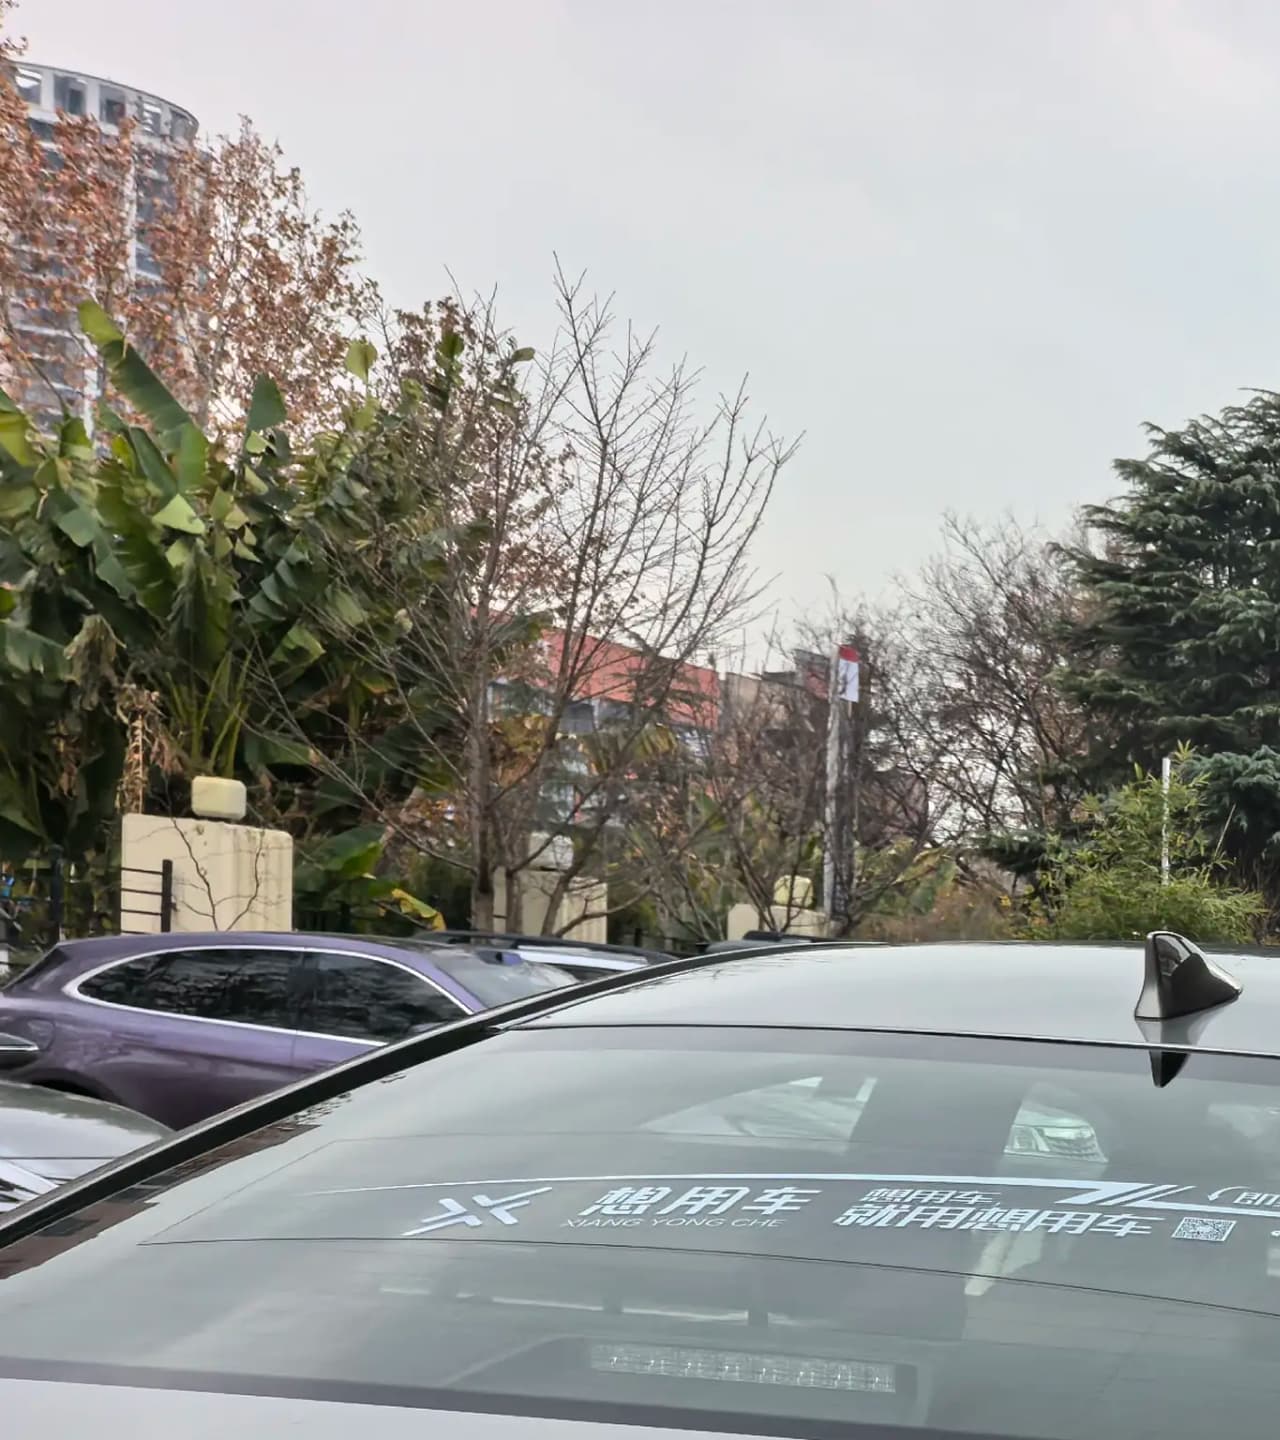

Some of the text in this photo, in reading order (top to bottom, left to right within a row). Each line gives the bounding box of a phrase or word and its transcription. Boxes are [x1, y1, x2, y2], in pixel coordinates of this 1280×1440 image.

[577, 1186, 822, 1215] 想用车
[560, 1218, 788, 1227] XIANG YONG CHE
[833, 1204, 1165, 1237] 就用想用车
